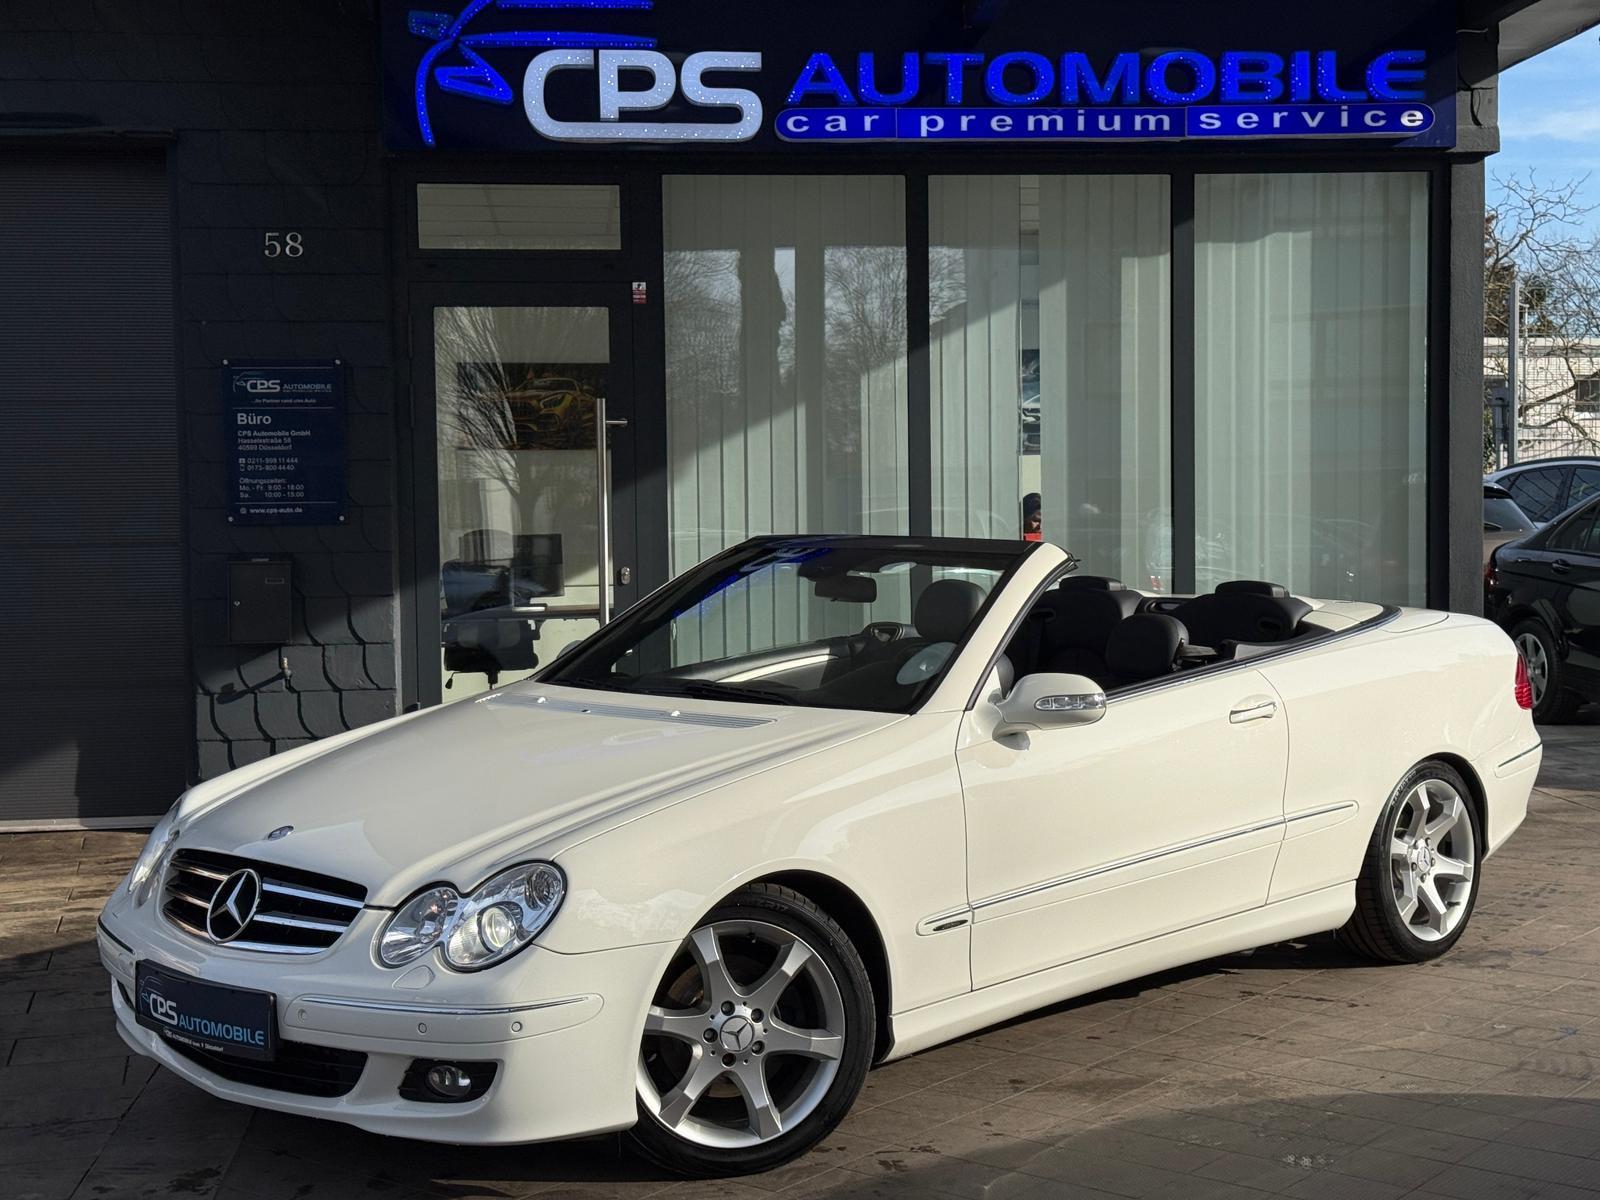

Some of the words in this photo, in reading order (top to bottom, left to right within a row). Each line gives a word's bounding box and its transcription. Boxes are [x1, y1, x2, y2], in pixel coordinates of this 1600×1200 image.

[523, 49, 763, 143] CPS
[785, 50, 1426, 105] AUTOMOBILE
[786, 114, 880, 132] car
[920, 109, 1171, 137] premium
[1199, 105, 1425, 129] service
[264, 231, 304, 257] 58
[246, 379, 281, 393] CPS
[237, 412, 272, 425] Büro
[252, 429, 289, 437] Automobile
[290, 429, 311, 437] GmbH
[149, 993, 178, 1026] CPS
[178, 1014, 265, 1046] AUTOMOBILE
